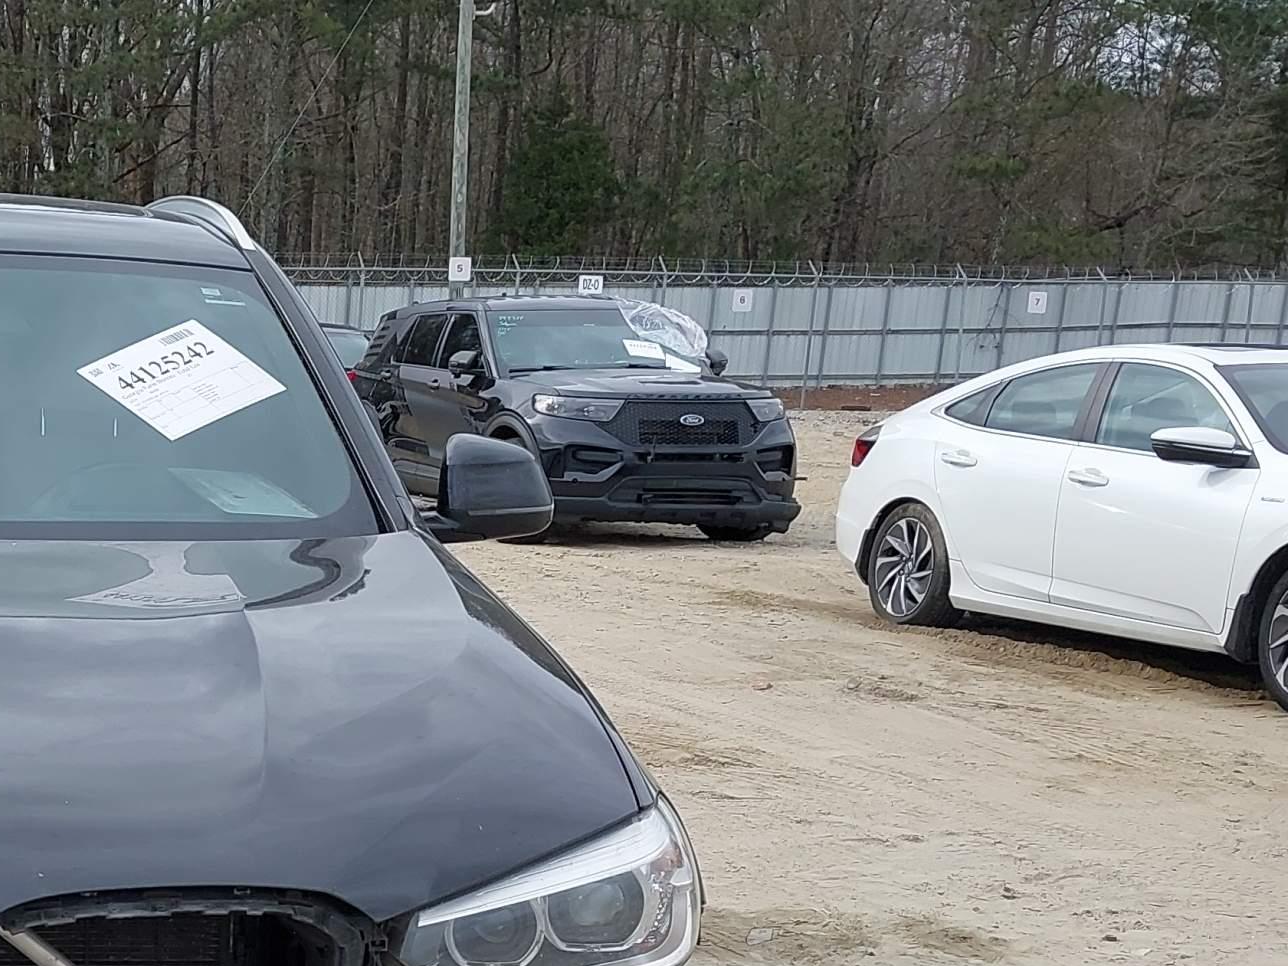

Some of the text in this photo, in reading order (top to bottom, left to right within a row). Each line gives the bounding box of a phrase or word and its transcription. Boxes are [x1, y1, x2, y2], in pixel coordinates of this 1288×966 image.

[456, 264, 464, 273] 5
[739, 295, 746, 305] 6
[1034, 297, 1041, 306] 7
[118, 341, 215, 390] 44125242
